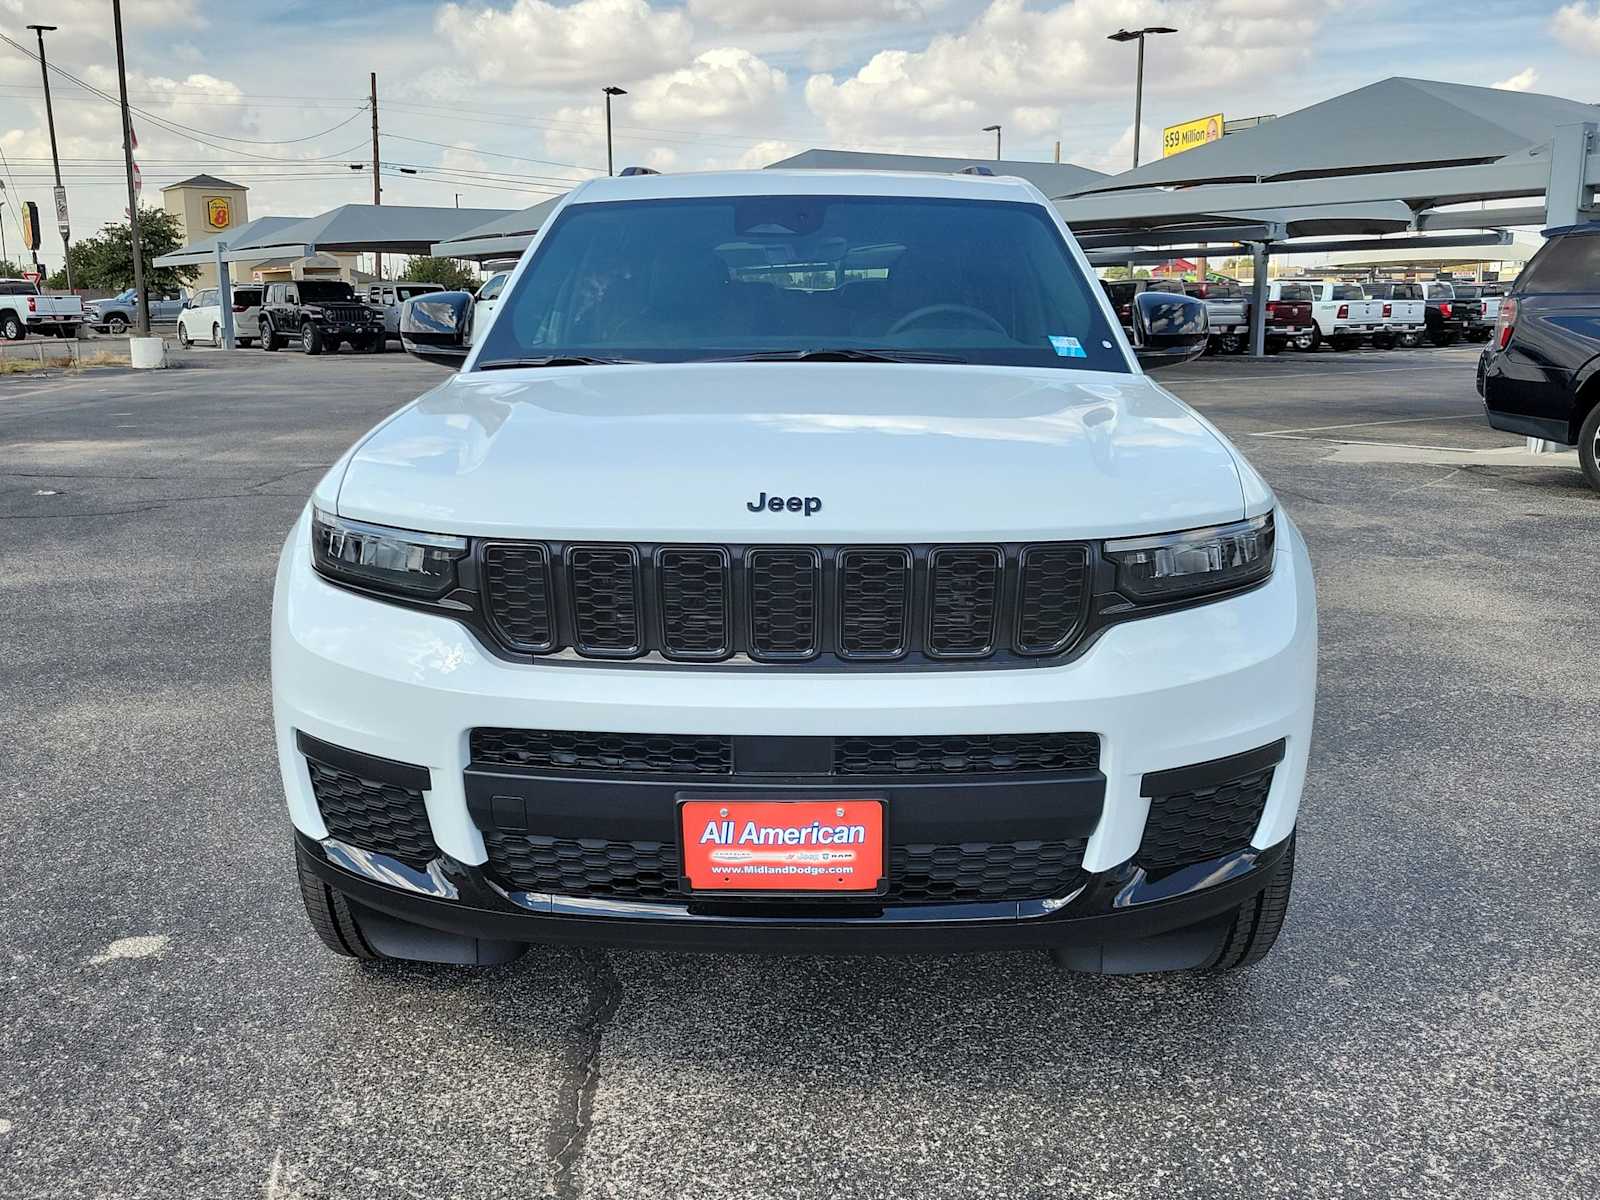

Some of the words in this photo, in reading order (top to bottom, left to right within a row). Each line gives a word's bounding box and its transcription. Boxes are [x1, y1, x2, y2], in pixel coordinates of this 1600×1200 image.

[1164, 130, 1180, 148] $59
[1181, 128, 1205, 145] Million
[746, 492, 822, 516] Jeep
[700, 820, 736, 845] All
[738, 820, 866, 845] American
[711, 865, 854, 876] www.MidlandDodge.com
